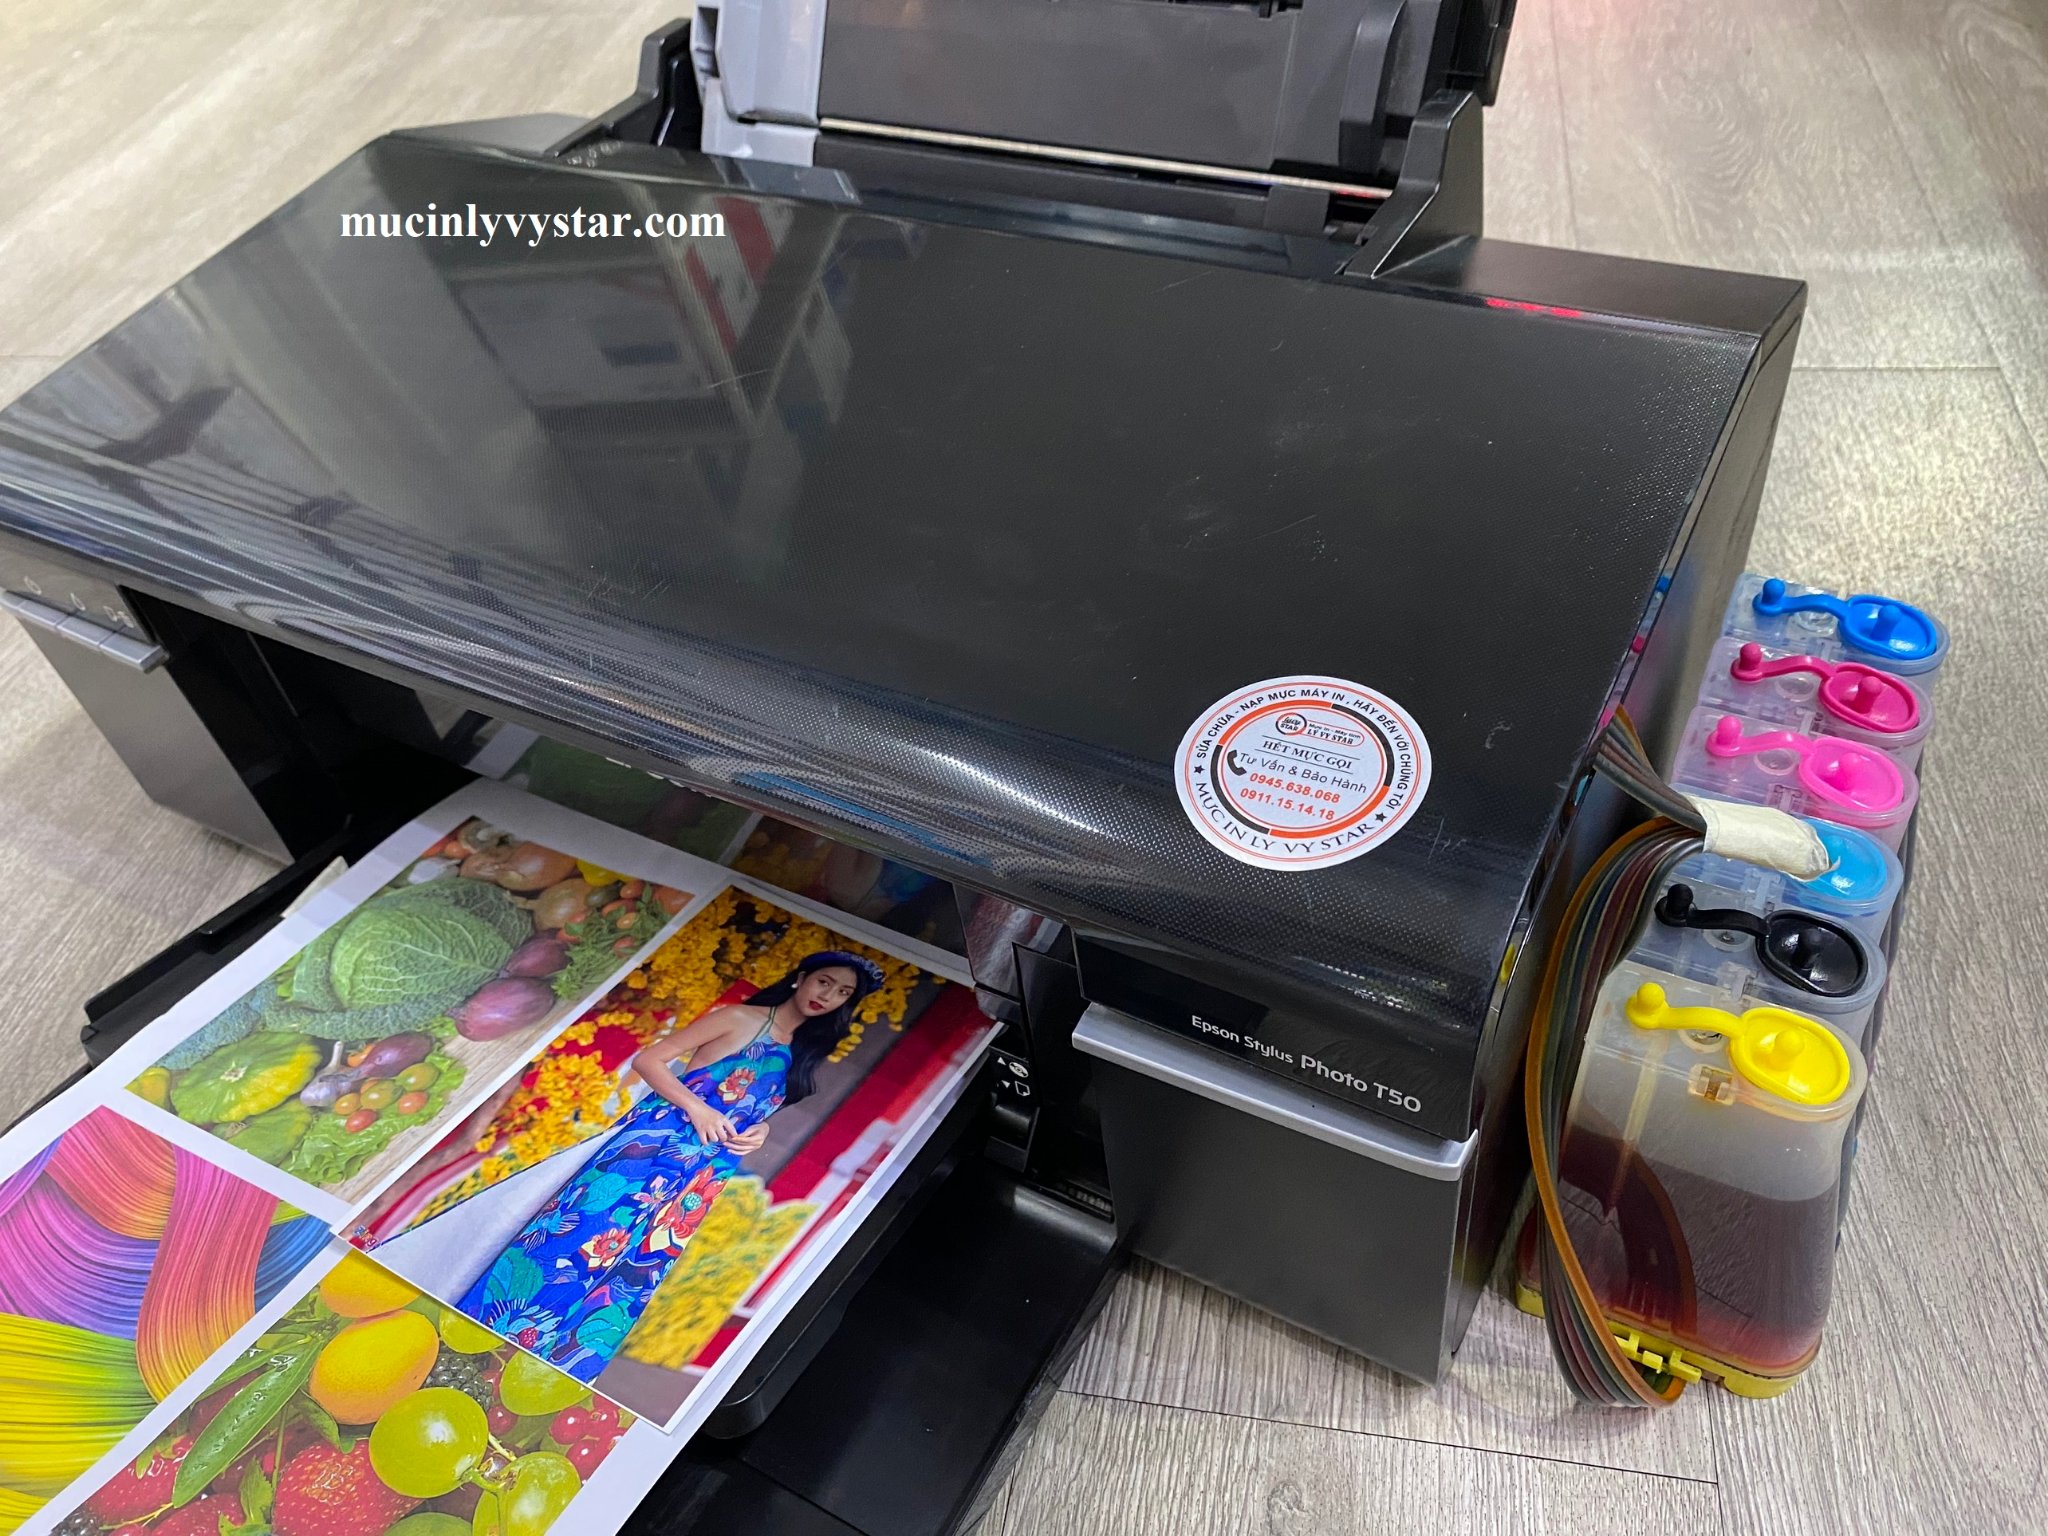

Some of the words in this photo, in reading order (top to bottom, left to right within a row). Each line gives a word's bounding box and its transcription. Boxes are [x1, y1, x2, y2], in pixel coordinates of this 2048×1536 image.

[1268, 690, 1296, 701] MỰC
[1301, 688, 1329, 697] MÁY
[1332, 692, 1345, 701] IN
[1239, 697, 1264, 711] NẠP
[1207, 713, 1235, 737] CHỮA
[1377, 715, 1398, 733] ĐẾN
[1320, 731, 1332, 739] VY
[1331, 734, 1354, 745] STAR
[1393, 734, 1410, 751] VỚI
[1196, 739, 1212, 759] SỬA
[1292, 747, 1324, 762] MỰC
[1326, 755, 1353, 769] GỌI
[1240, 753, 1257, 765] Tư
[1261, 758, 1285, 772] Vấn
[1288, 766, 1298, 776] &
[1301, 768, 1328, 783] Bảo
[1331, 776, 1367, 793] Hành
[1397, 753, 1414, 790] CHÚNG
[1249, 772, 1341, 804] 0945.638.068
[1240, 788, 1335, 820] 0911.15.14.18
[1386, 793, 1404, 810] TÔI
[1196, 781, 1226, 823] MỰC
[1224, 821, 1247, 840] IN
[1284, 841, 1315, 853] VY
[1320, 823, 1375, 851] STAR
[1191, 1015, 1240, 1043] Epson
[1244, 1035, 1294, 1064] Stylus
[1300, 1054, 1368, 1092] Photo
[1373, 1082, 1422, 1113] T50
